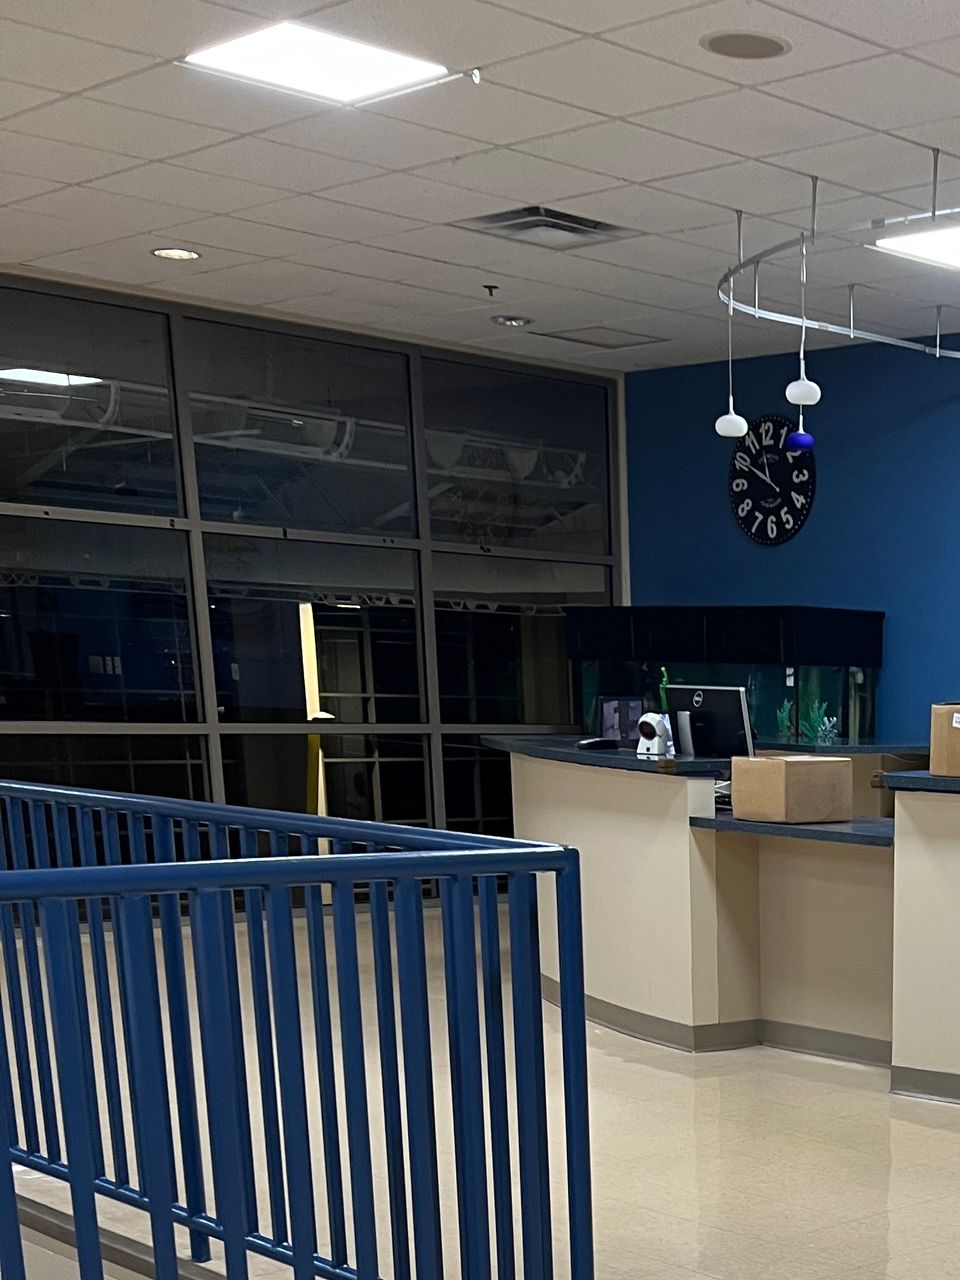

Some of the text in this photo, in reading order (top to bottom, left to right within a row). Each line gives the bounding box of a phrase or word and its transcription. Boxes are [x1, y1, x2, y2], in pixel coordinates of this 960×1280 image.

[745, 430, 760, 454] 11
[760, 421, 774, 446] 12
[779, 426, 788, 449] 1
[734, 451, 750, 472] 10
[732, 478, 748, 492] 9
[792, 468, 809, 483] 3
[738, 498, 752, 517] 8
[790, 490, 806, 509] 4
[751, 511, 763, 533] 7
[767, 515, 777, 538] 6
[780, 506, 794, 529] 5
